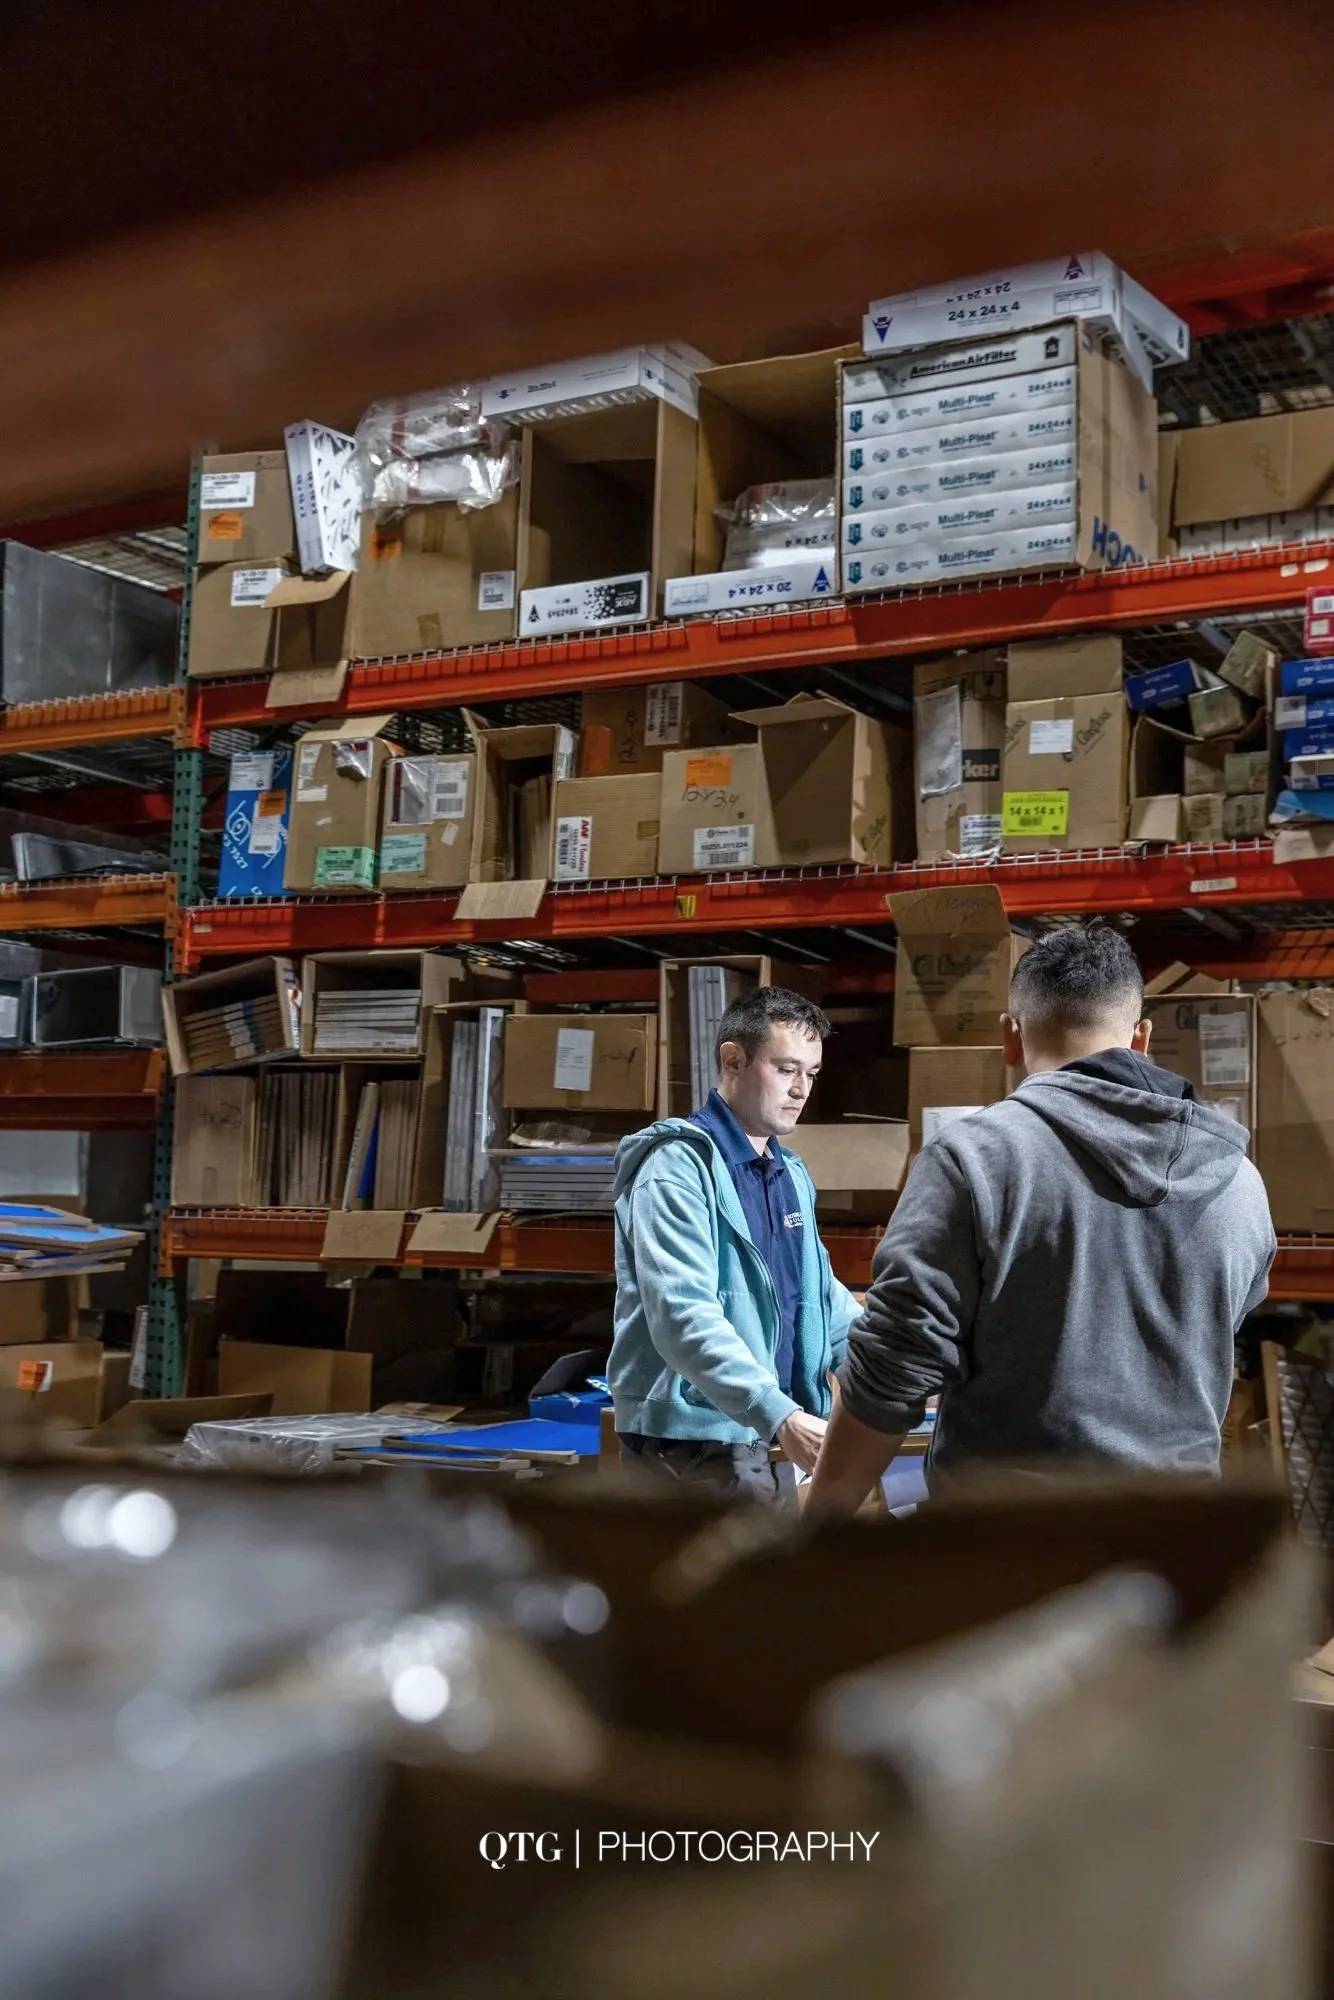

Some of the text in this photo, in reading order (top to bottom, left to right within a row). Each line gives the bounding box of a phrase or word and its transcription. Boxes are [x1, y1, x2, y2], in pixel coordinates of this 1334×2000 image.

[948, 301, 1020, 321] 24 x 24 x 4
[728, 582, 792, 599] 20 x 24 x 4
[1009, 806, 1021, 815] 14
[1034, 806, 1046, 816] 14
